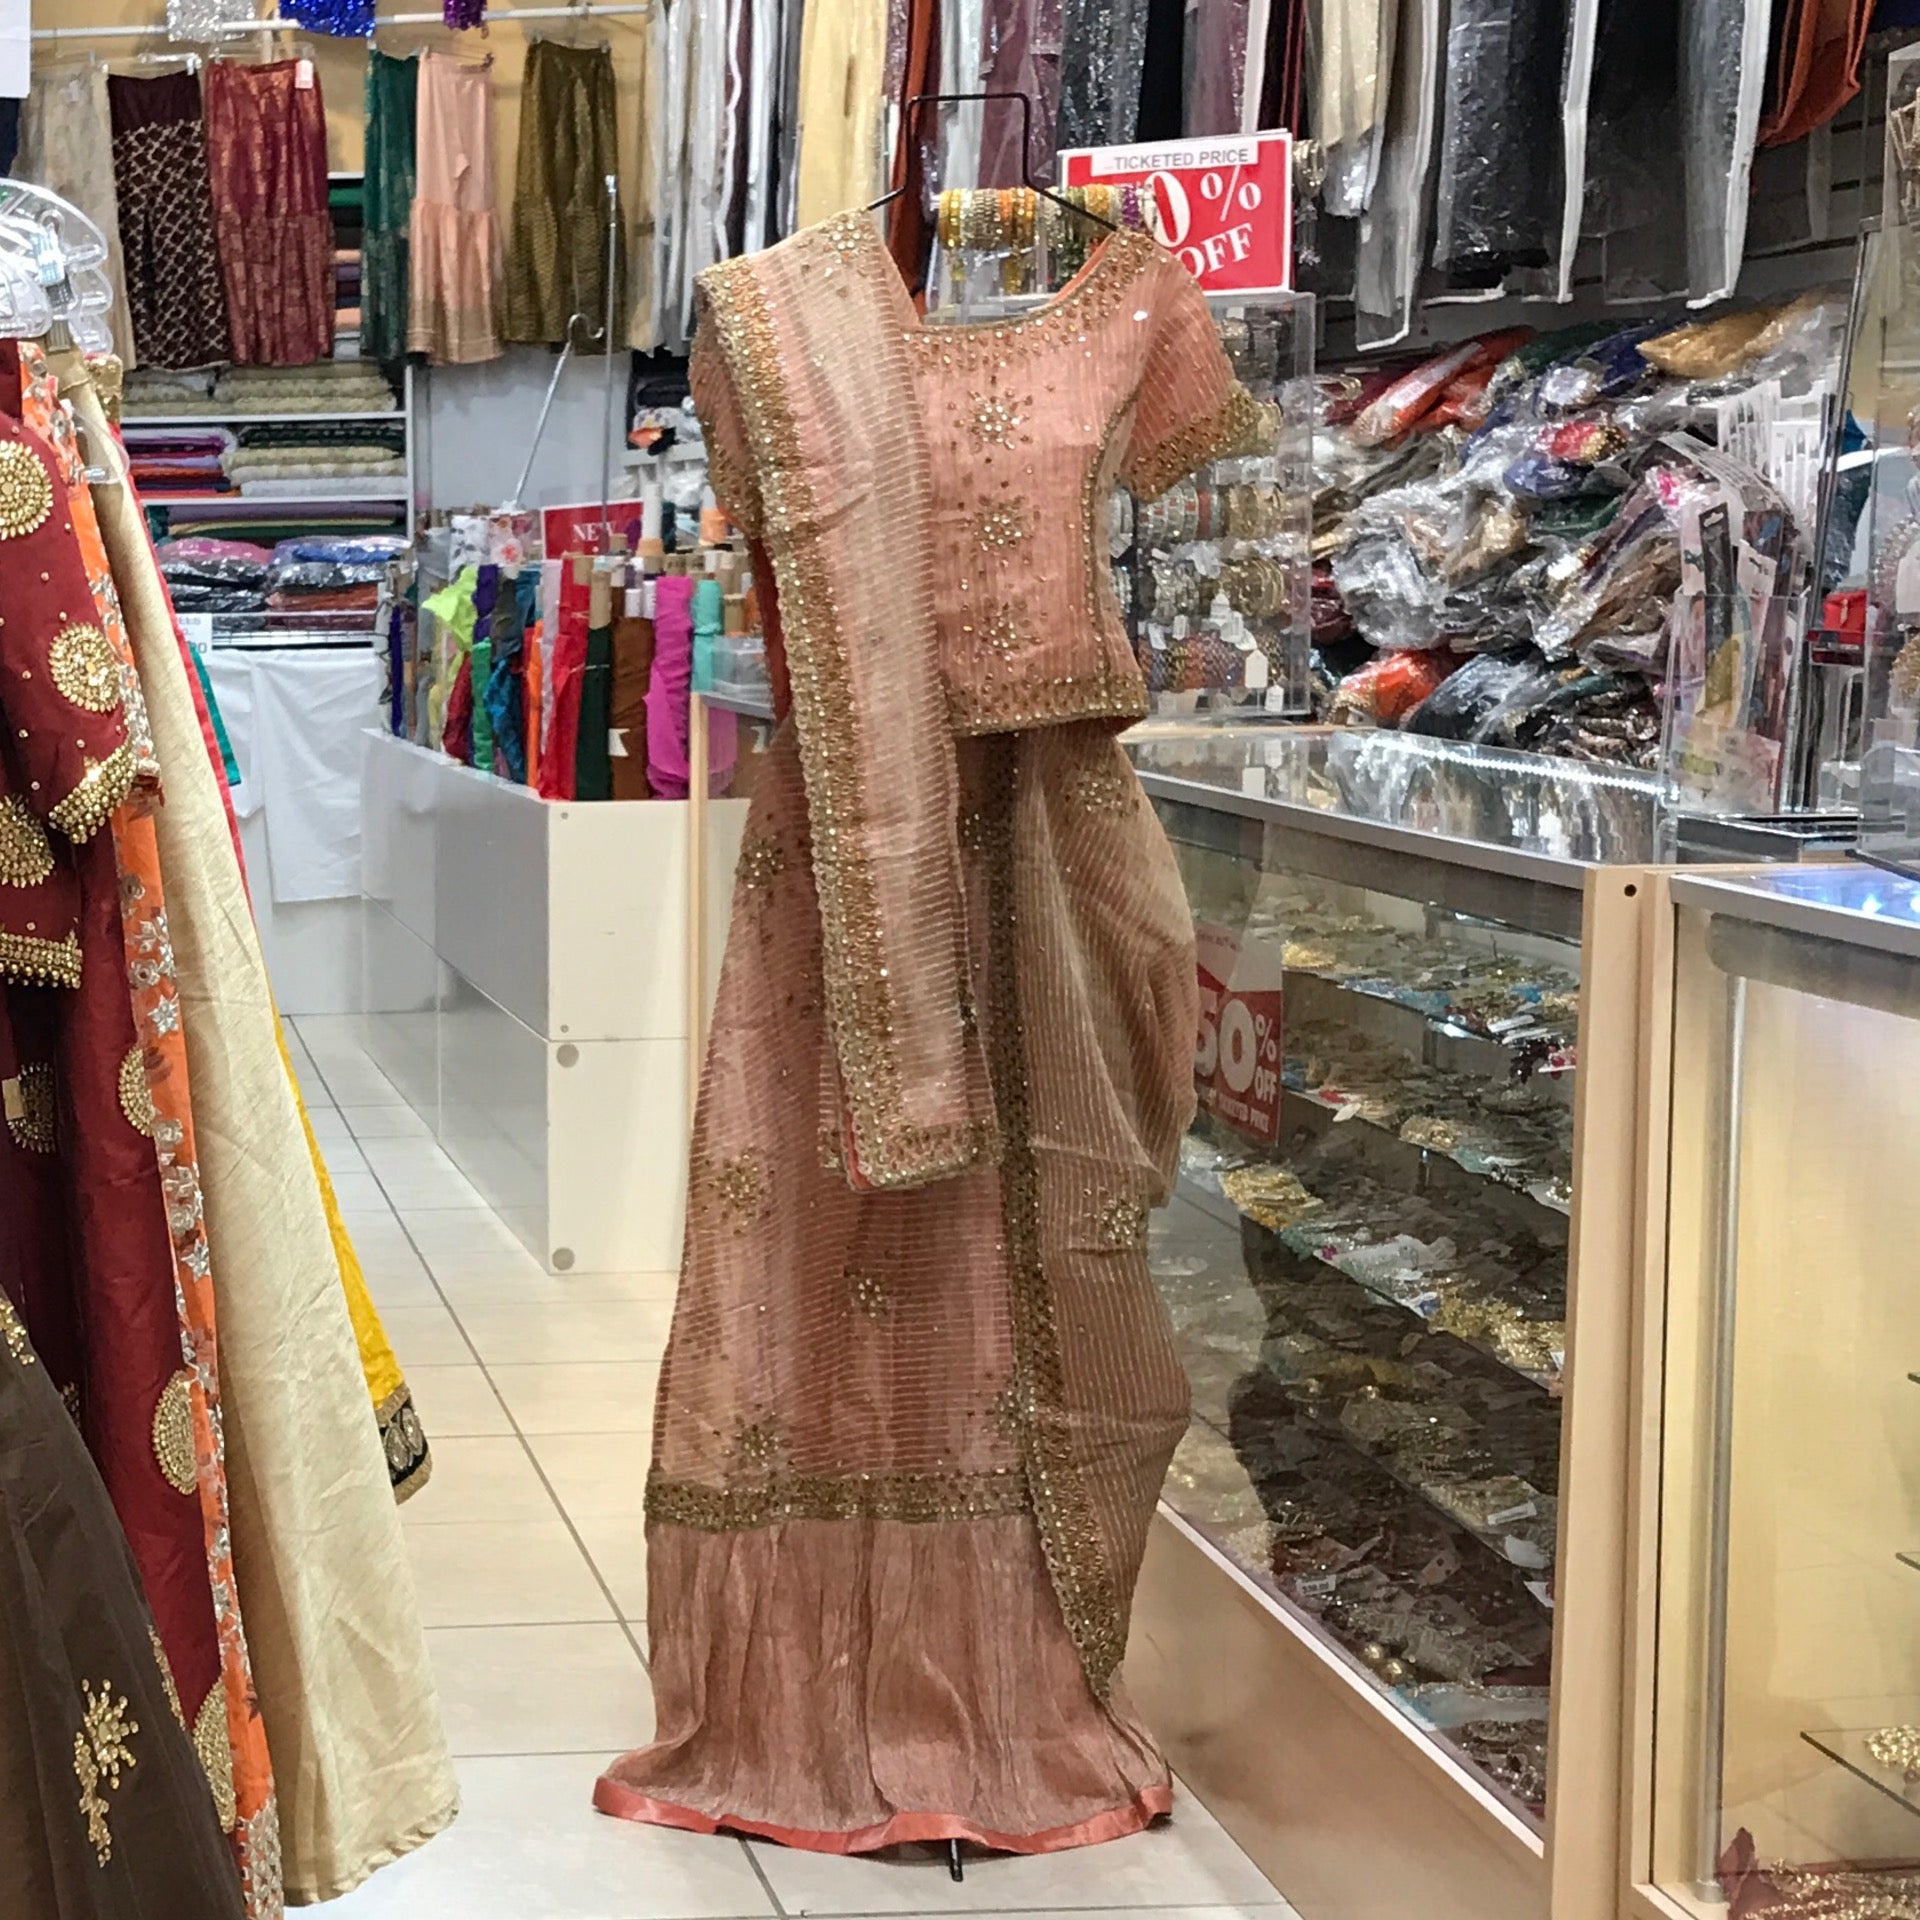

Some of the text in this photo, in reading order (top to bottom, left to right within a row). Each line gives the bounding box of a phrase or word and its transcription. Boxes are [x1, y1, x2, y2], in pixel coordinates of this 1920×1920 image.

[1115, 148, 1249, 170] TICKETED PRICE
[1175, 223, 1254, 280] OFF
[1254, 1065, 1278, 1105] OFF
